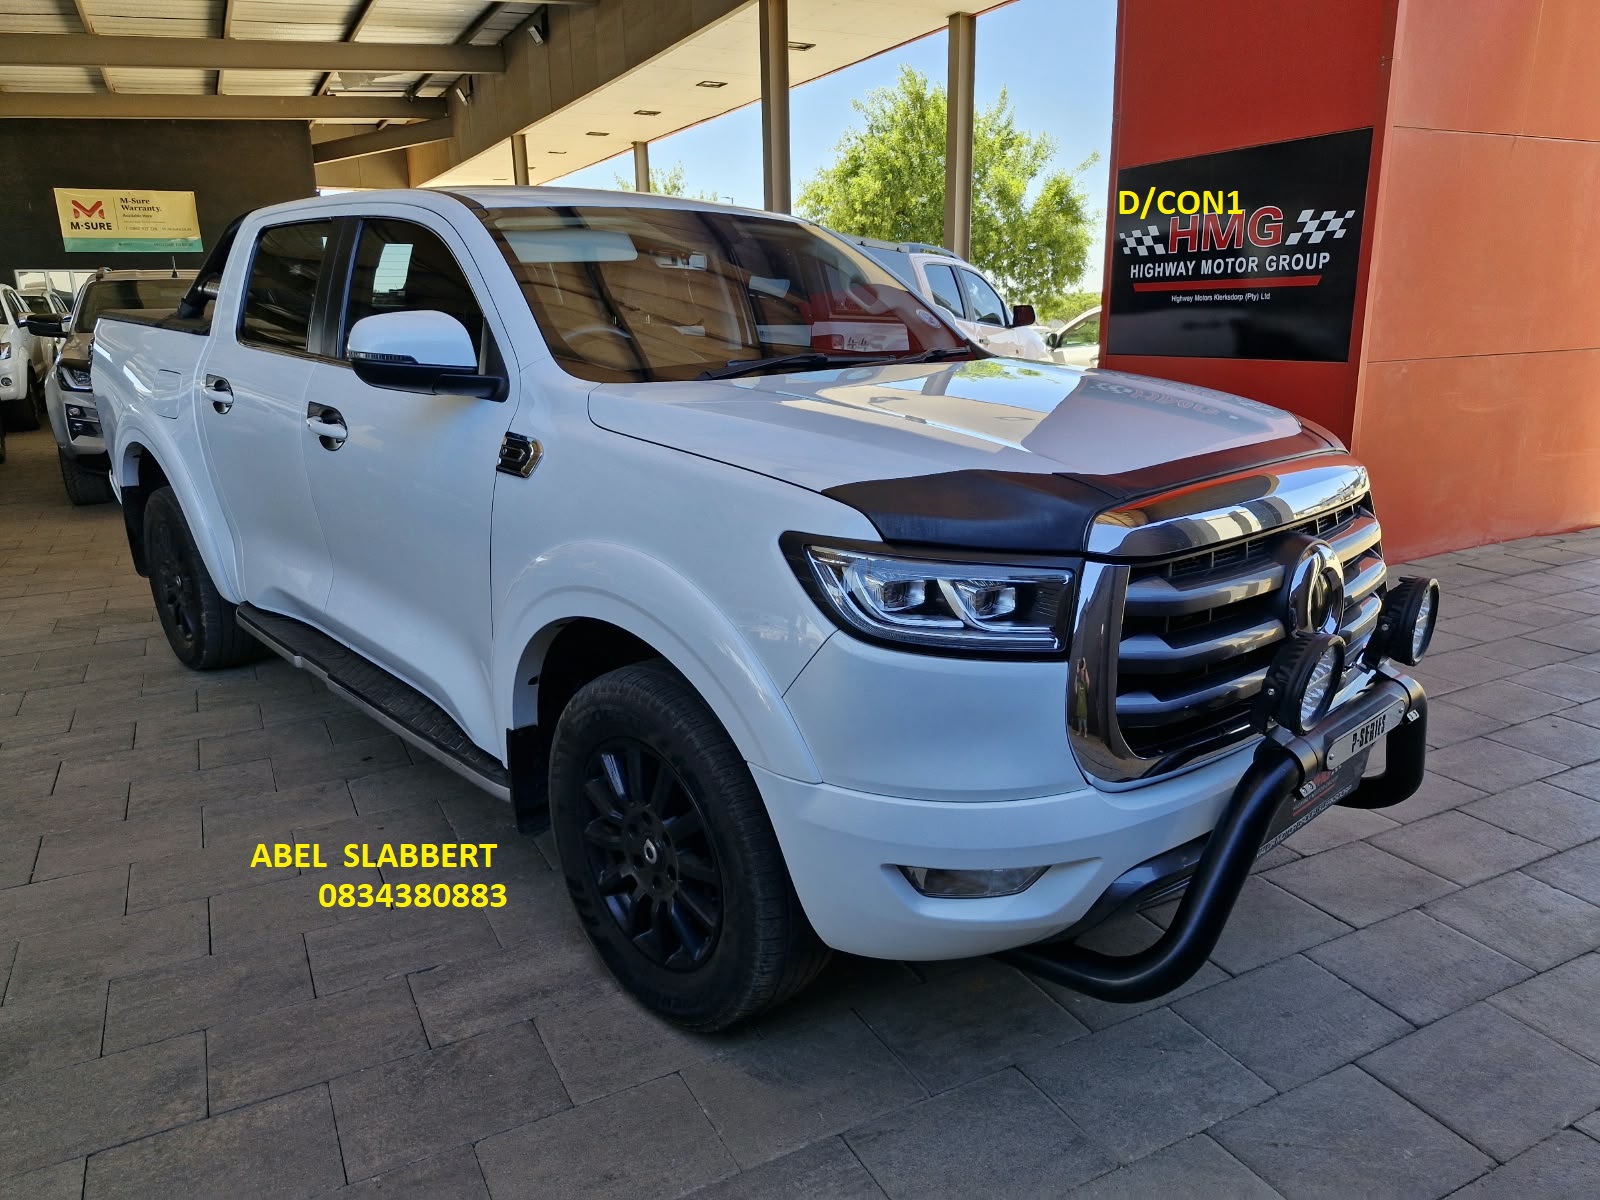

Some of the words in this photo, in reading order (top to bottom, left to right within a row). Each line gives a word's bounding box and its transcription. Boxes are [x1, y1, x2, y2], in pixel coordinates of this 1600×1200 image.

[120, 197, 150, 205] M-Sure
[1168, 205, 1284, 254] HMG
[1130, 260, 1196, 279] HIGHWAY
[1200, 256, 1259, 275] MOTOR
[1265, 252, 1331, 272] GROUP
[1171, 294, 1193, 304] Highway
[1194, 294, 1213, 302] Motors
[1214, 293, 1244, 302] Klerksdorp
[1244, 292, 1259, 302] (Pty)
[1260, 292, 1271, 300] Ltd
[1351, 714, 1386, 753] P-SERIES
